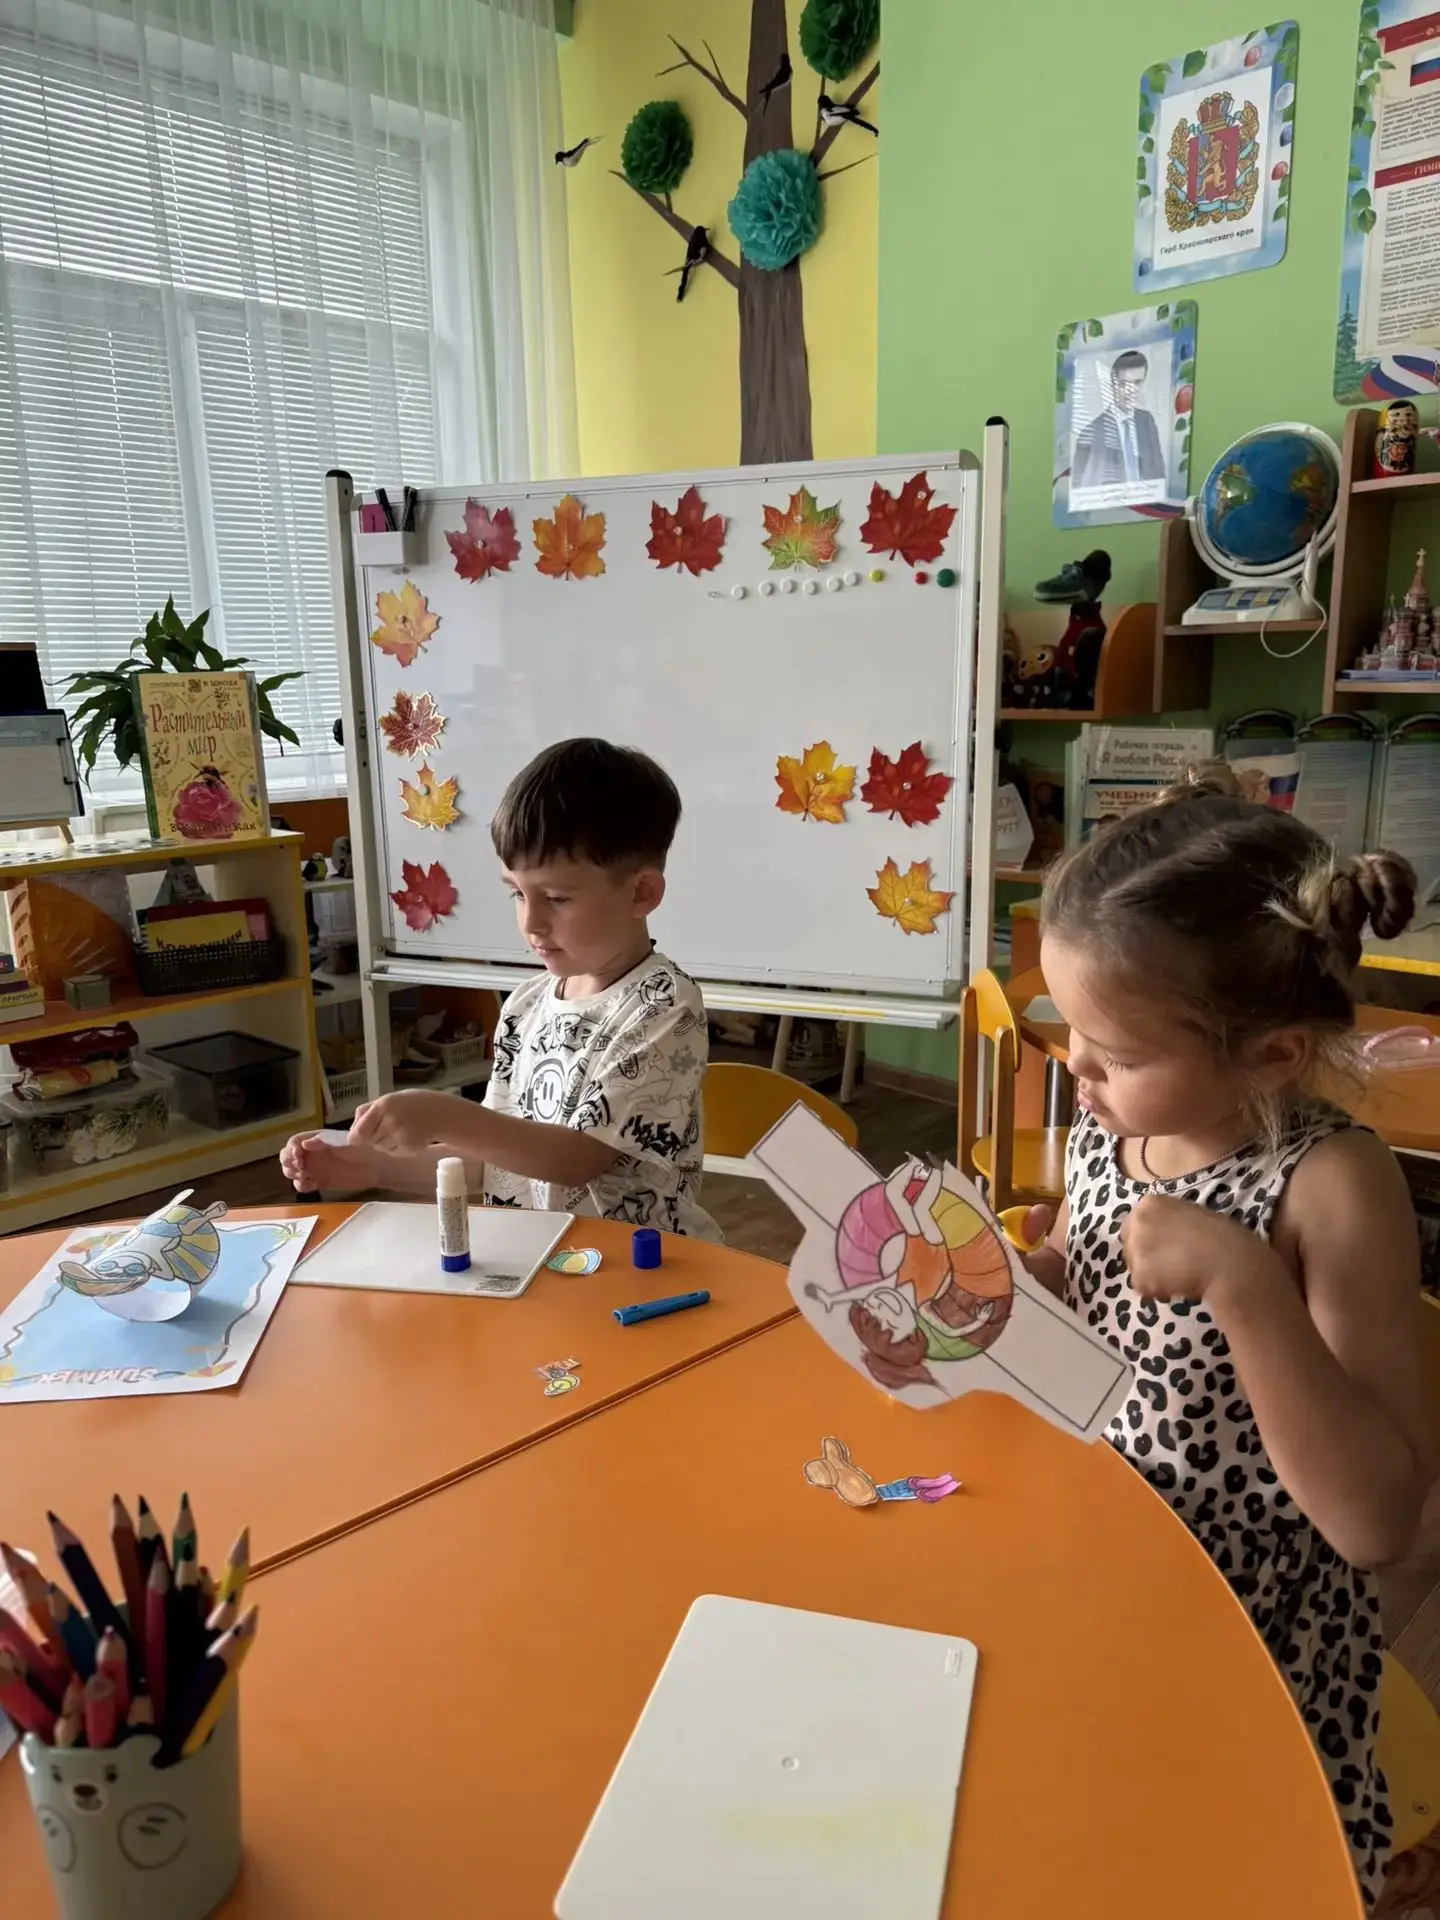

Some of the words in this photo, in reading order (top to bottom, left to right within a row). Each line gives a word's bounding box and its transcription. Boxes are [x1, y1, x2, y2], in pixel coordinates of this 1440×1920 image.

[1160, 245, 1178, 255] Герб
[1178, 232, 1235, 250] Красноярского
[1236, 227, 1255, 237] края
[150, 702, 247, 734] Растительный
[187, 735, 217, 762] мир
[1101, 751, 1111, 764] Я
[1114, 753, 1150, 766] люблю
[37, 1366, 157, 1385] SUMMER
